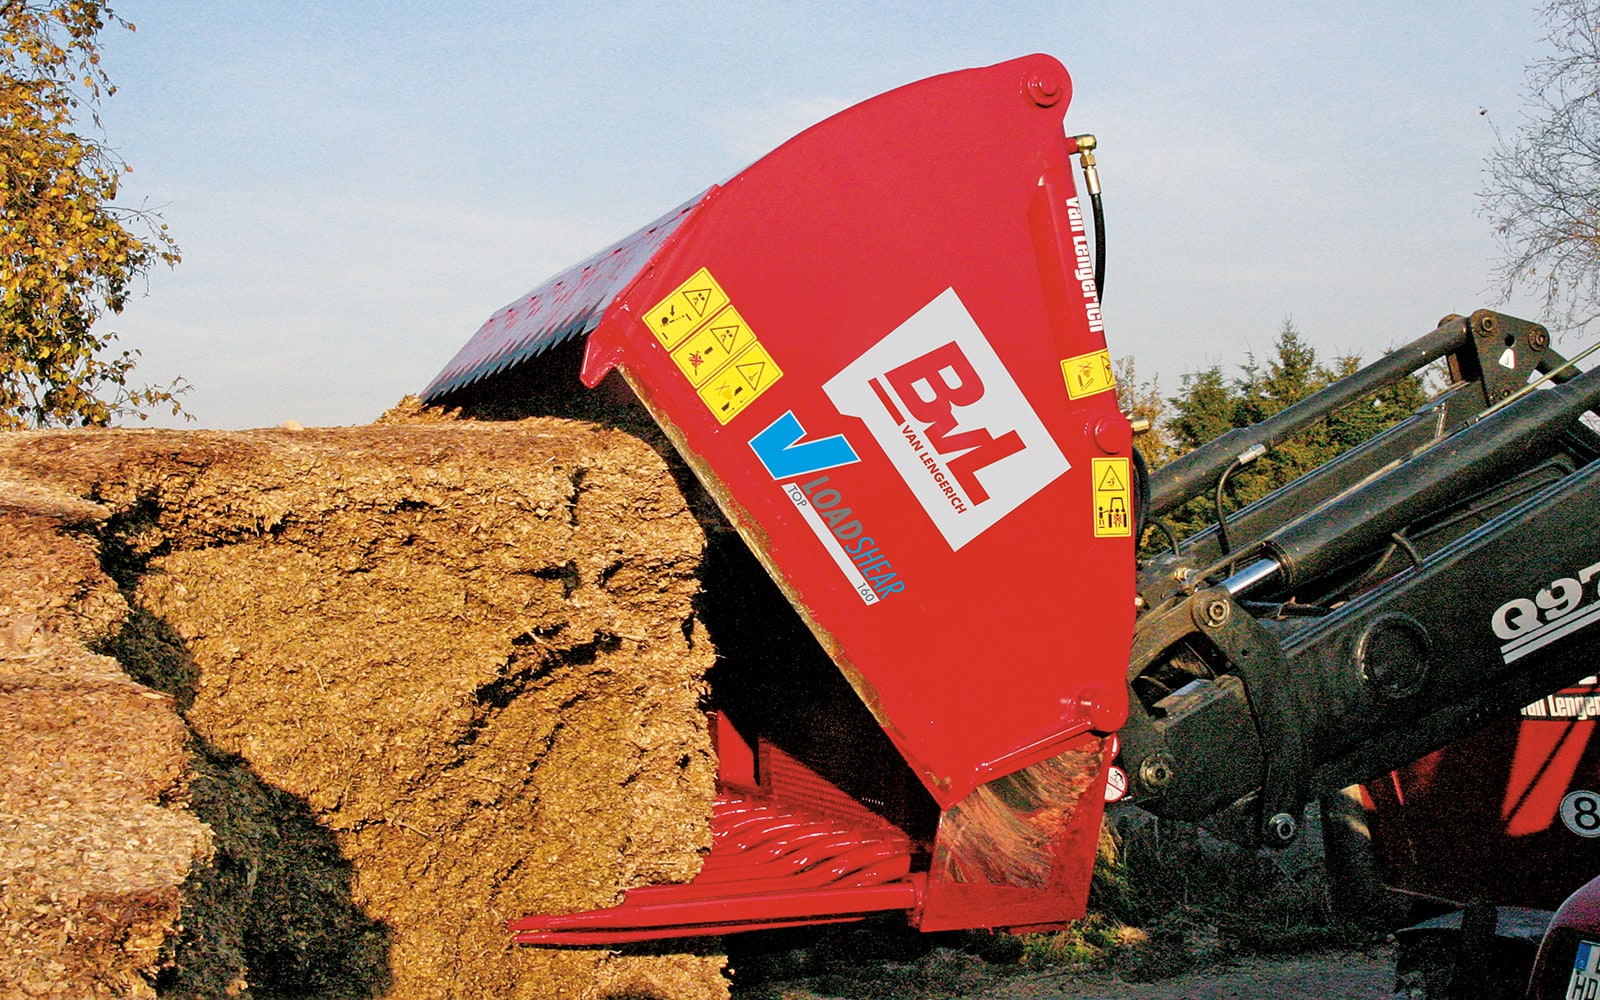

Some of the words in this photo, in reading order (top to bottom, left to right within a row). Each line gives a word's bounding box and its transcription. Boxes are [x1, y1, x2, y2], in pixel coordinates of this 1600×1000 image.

[902, 424, 924, 452] VAN
[919, 452, 967, 515] LENGERICH
[787, 485, 808, 508] TOP
[857, 582, 875, 603] 160
